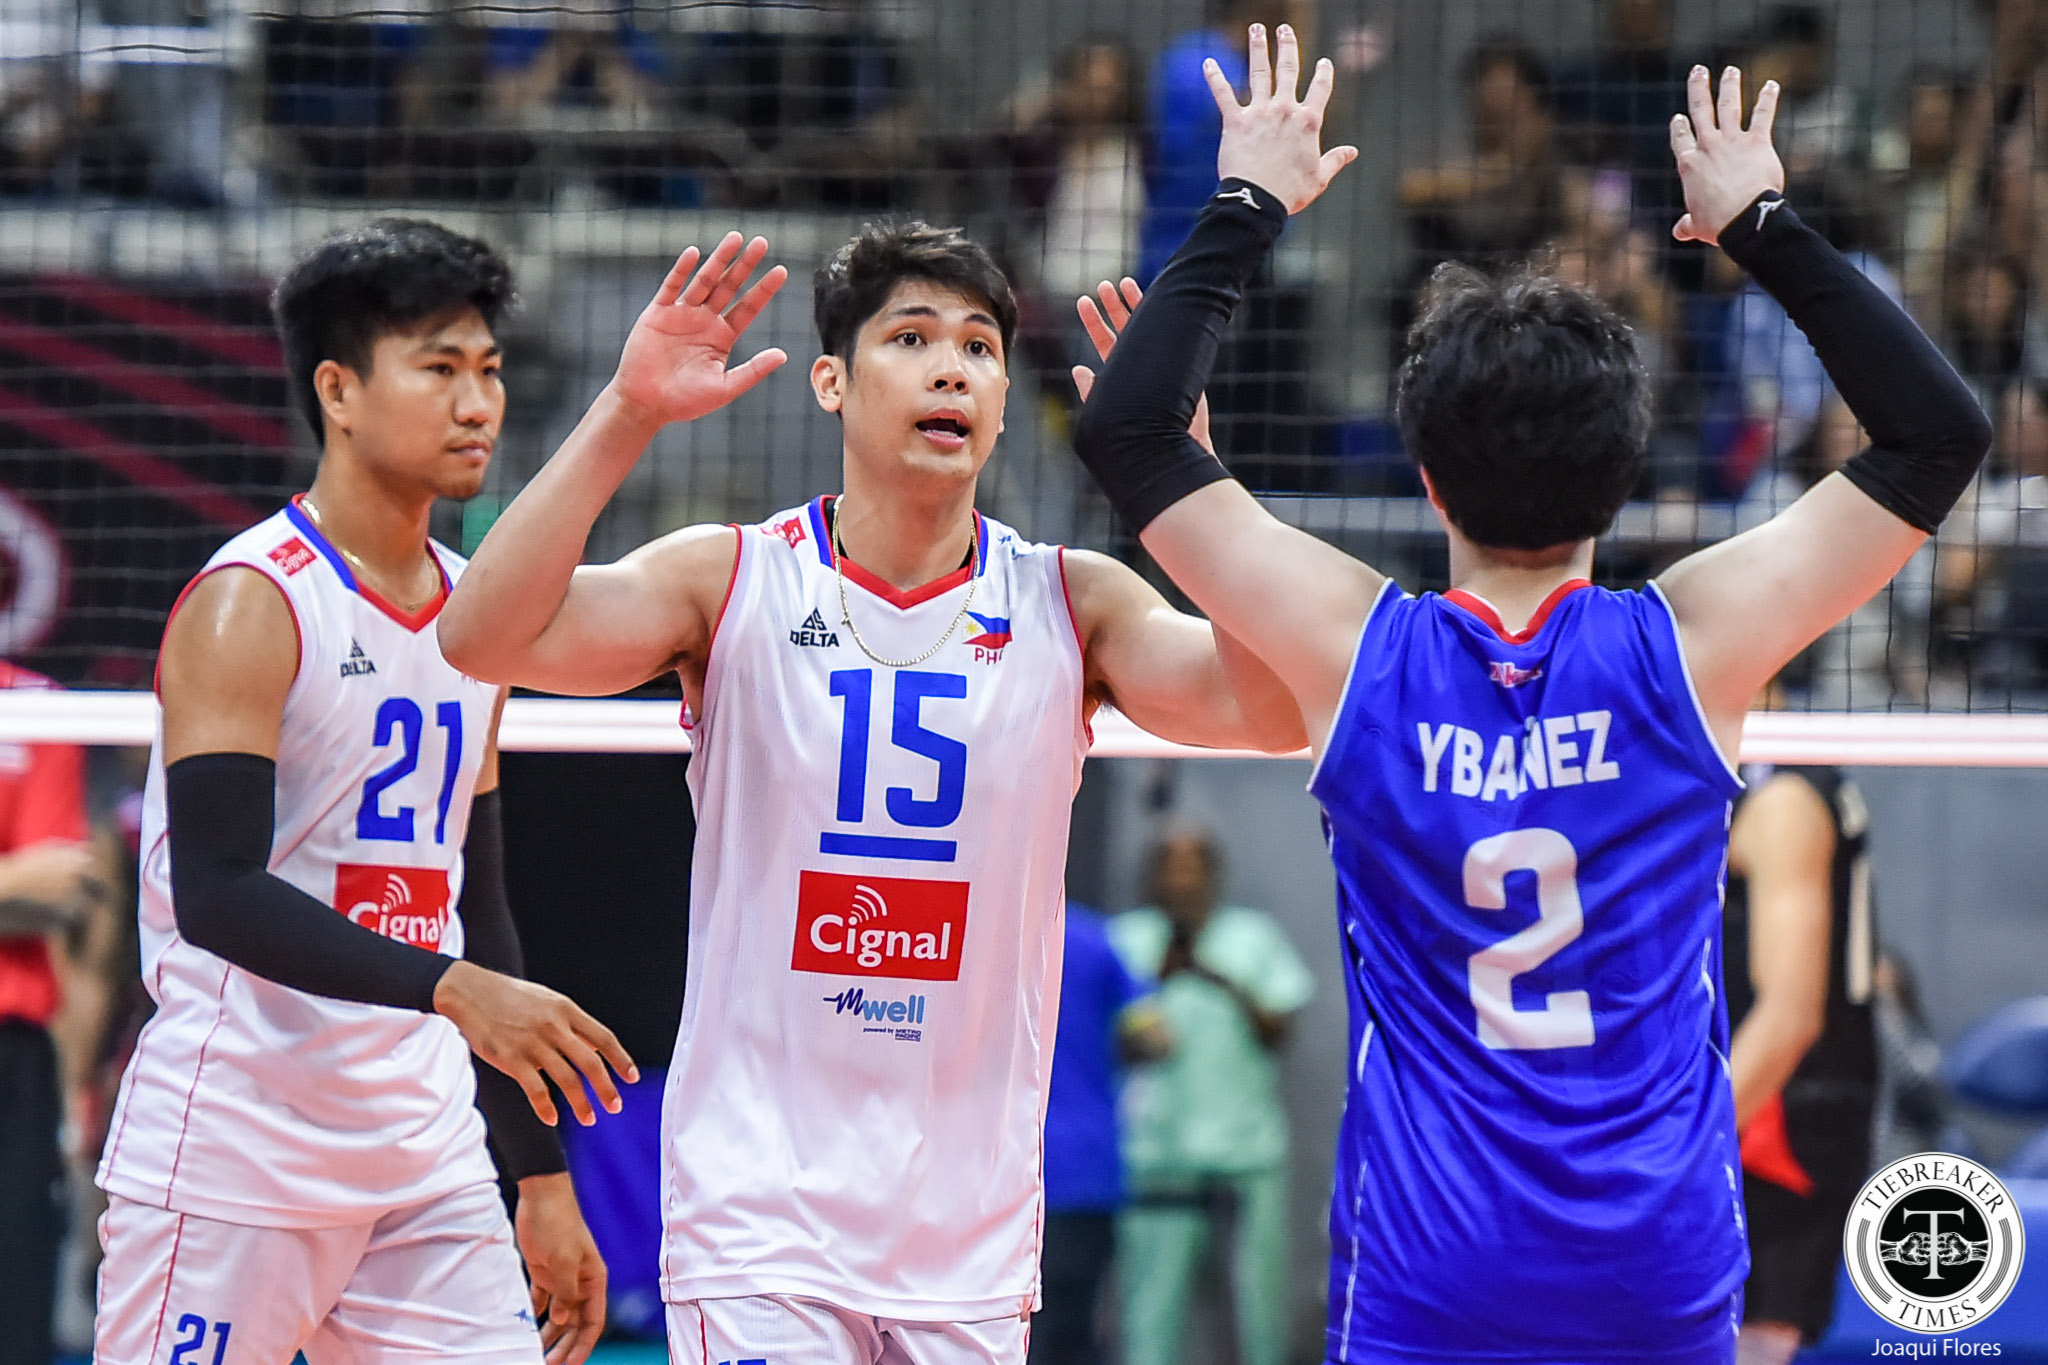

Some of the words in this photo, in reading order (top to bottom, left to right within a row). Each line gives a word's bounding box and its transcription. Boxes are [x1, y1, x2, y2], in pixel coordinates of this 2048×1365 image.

[790, 630, 840, 648] DELTA
[356, 697, 463, 844] 21
[829, 668, 967, 828] 15
[1417, 710, 1620, 802] YBAÑEZ
[810, 914, 952, 968] Cignal
[1462, 827, 1595, 1050] 2
[169, 1313, 232, 1365] 21
